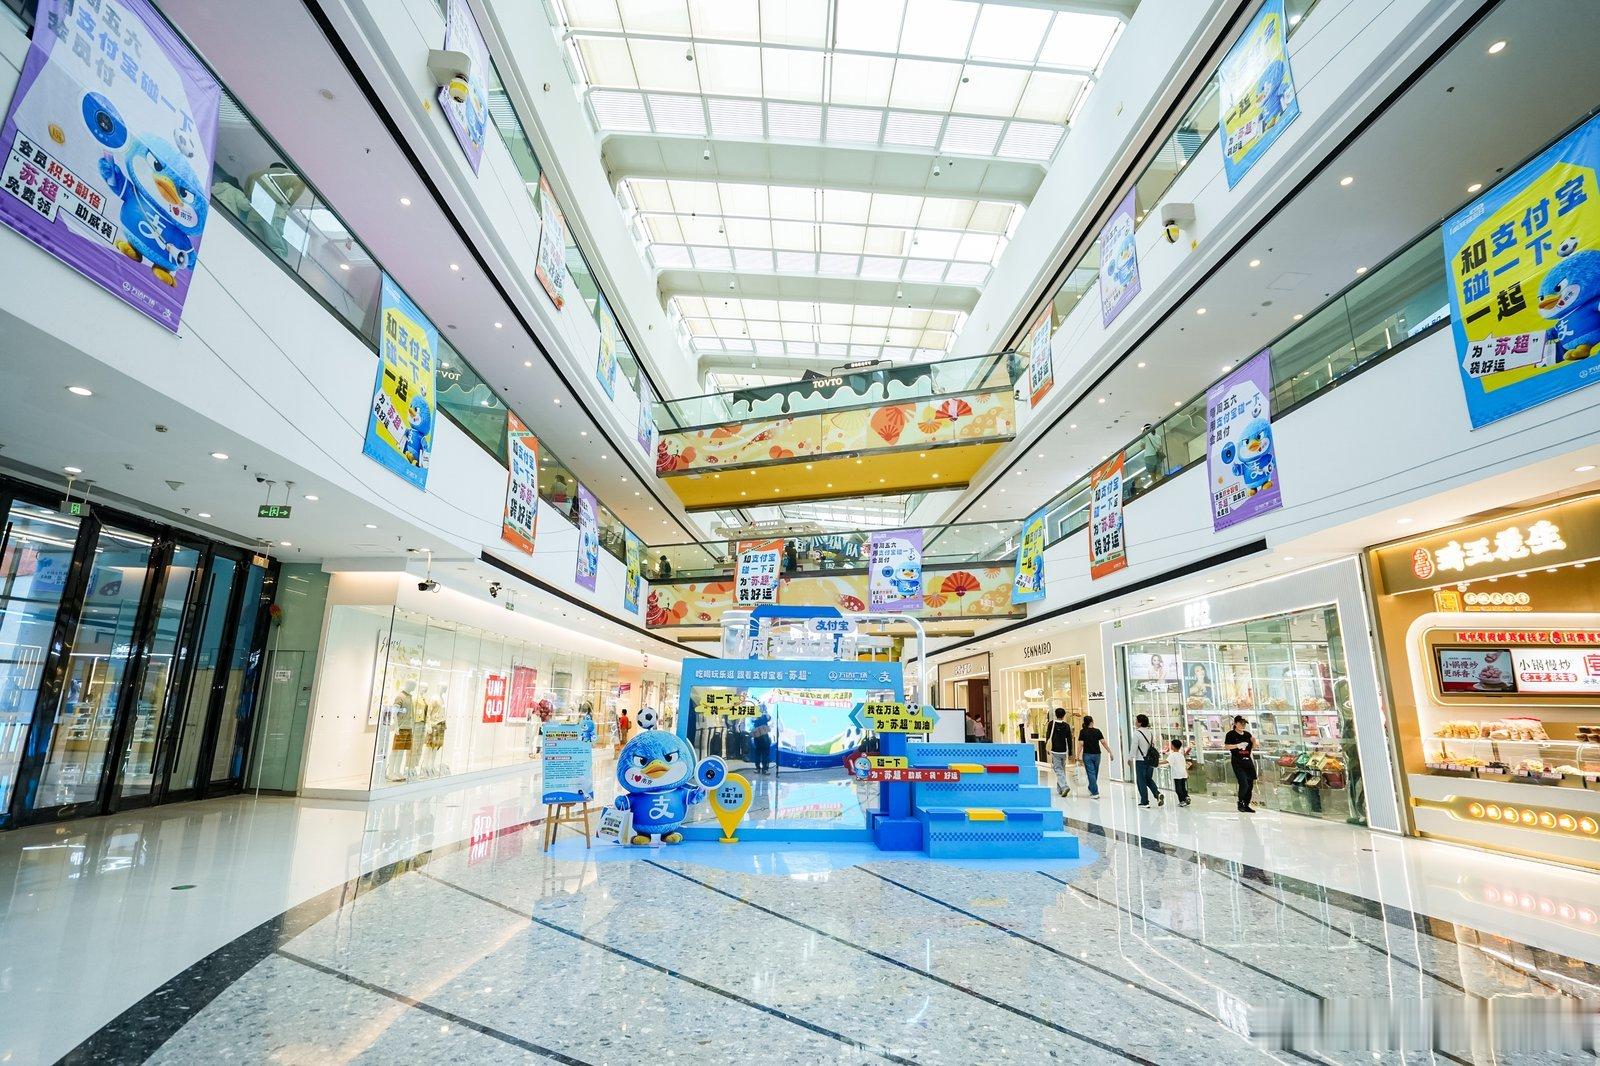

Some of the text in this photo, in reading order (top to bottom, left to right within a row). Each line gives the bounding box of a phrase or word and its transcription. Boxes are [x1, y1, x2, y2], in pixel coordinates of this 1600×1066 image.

[19, 140, 102, 210] 会员积分翻倍
[5, 175, 52, 217] 免费领
[1461, 174, 1588, 275] 和支付宝
[1463, 229, 1553, 305] 碰一下
[1466, 281, 1527, 325] 一起
[386, 312, 431, 373] 和支付宝
[1472, 334, 1539, 359] 为“苏超”
[386, 338, 420, 384] 碰一下
[1469, 358, 1505, 375] 袋好运
[385, 368, 409, 403] 一起
[812, 377, 843, 389] TOVTO
[1209, 425, 1230, 446] 会员付
[743, 553, 776, 563] 和支付宝
[740, 575, 773, 586] 为“苏超”
[740, 588, 773, 601] 袋好运
[815, 620, 849, 631] 支付宝
[1023, 641, 1052, 659] SENNAIBO
[1442, 660, 1479, 670] 小锅慢炒
[706, 694, 733, 704] 碰一下
[867, 705, 900, 715] 我在万达
[877, 758, 901, 767] 碰一下
